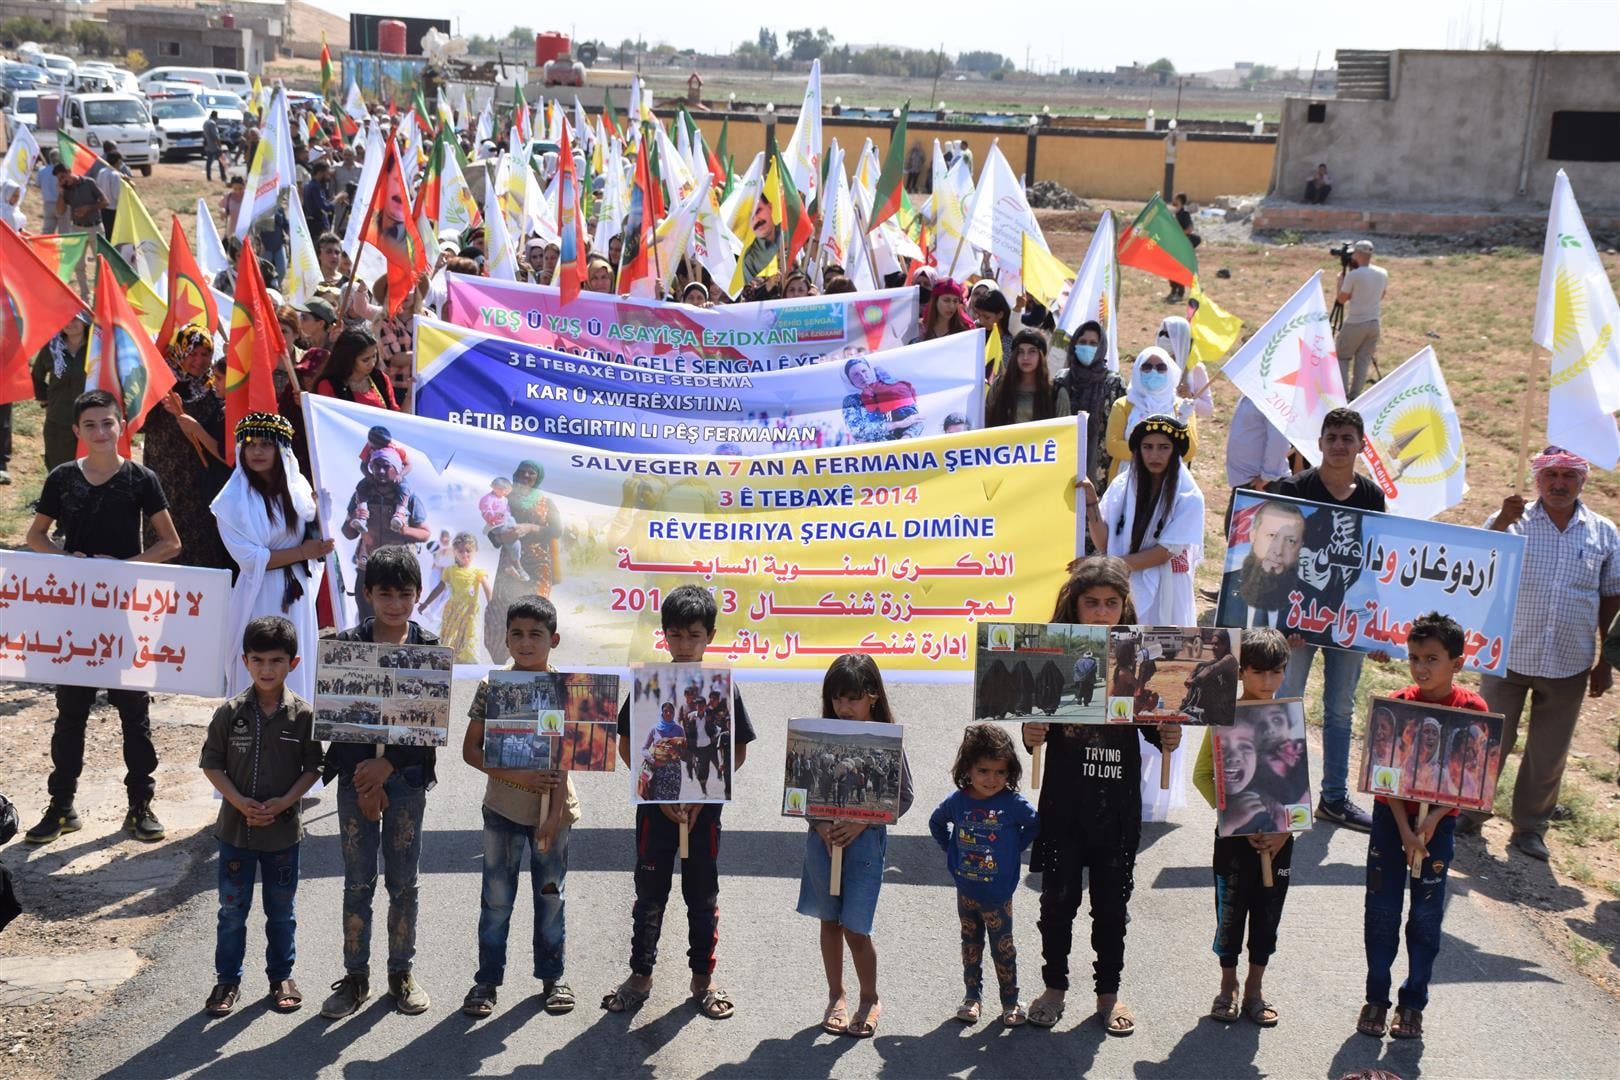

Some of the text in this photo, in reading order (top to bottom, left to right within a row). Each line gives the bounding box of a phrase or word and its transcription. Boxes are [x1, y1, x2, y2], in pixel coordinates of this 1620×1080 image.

[480, 307, 521, 331] YBŞ
[527, 309, 542, 329] Û
[547, 315, 582, 337] YJŞ
[588, 318, 602, 336] Û
[608, 324, 698, 348] ASAYÎŞA
[508, 352, 753, 389] 3 Ê TEBAXÊ DIBE SEDEMA
[526, 383, 743, 412] KAR Û XWERÊXISTINA
[448, 409, 817, 443] BÊTIR BO RÊGIRTIN LI PÊŞ FERMANAN
[571, 440, 1057, 477] SALVEGER A 7 AN A FERMANA ŞENGALÊ
[719, 485, 918, 507] 3 Ê TEBAXÊ 2014
[649, 514, 995, 544] RÊVEBIRIYA ŞENGAL DIMÎNE
[617, 547, 757, 581] السابعة
[763, 554, 886, 582] السنوية
[1399, 544, 1498, 597] أردوغان
[0, 573, 86, 609] العثماني
[186, 591, 204, 616] لا
[611, 587, 660, 611] 201
[722, 590, 738, 613] 3
[749, 592, 875, 621] شنكال
[881, 592, 1015, 622] لمجزرة
[1287, 591, 1359, 647] واحدة
[0, 629, 186, 673] بحق الإيزيديي
[775, 625, 916, 660] شنكال
[921, 631, 968, 661] إدارة
[1084, 746, 1121, 763] TRYING
[1082, 763, 1123, 779] TO LOVE
